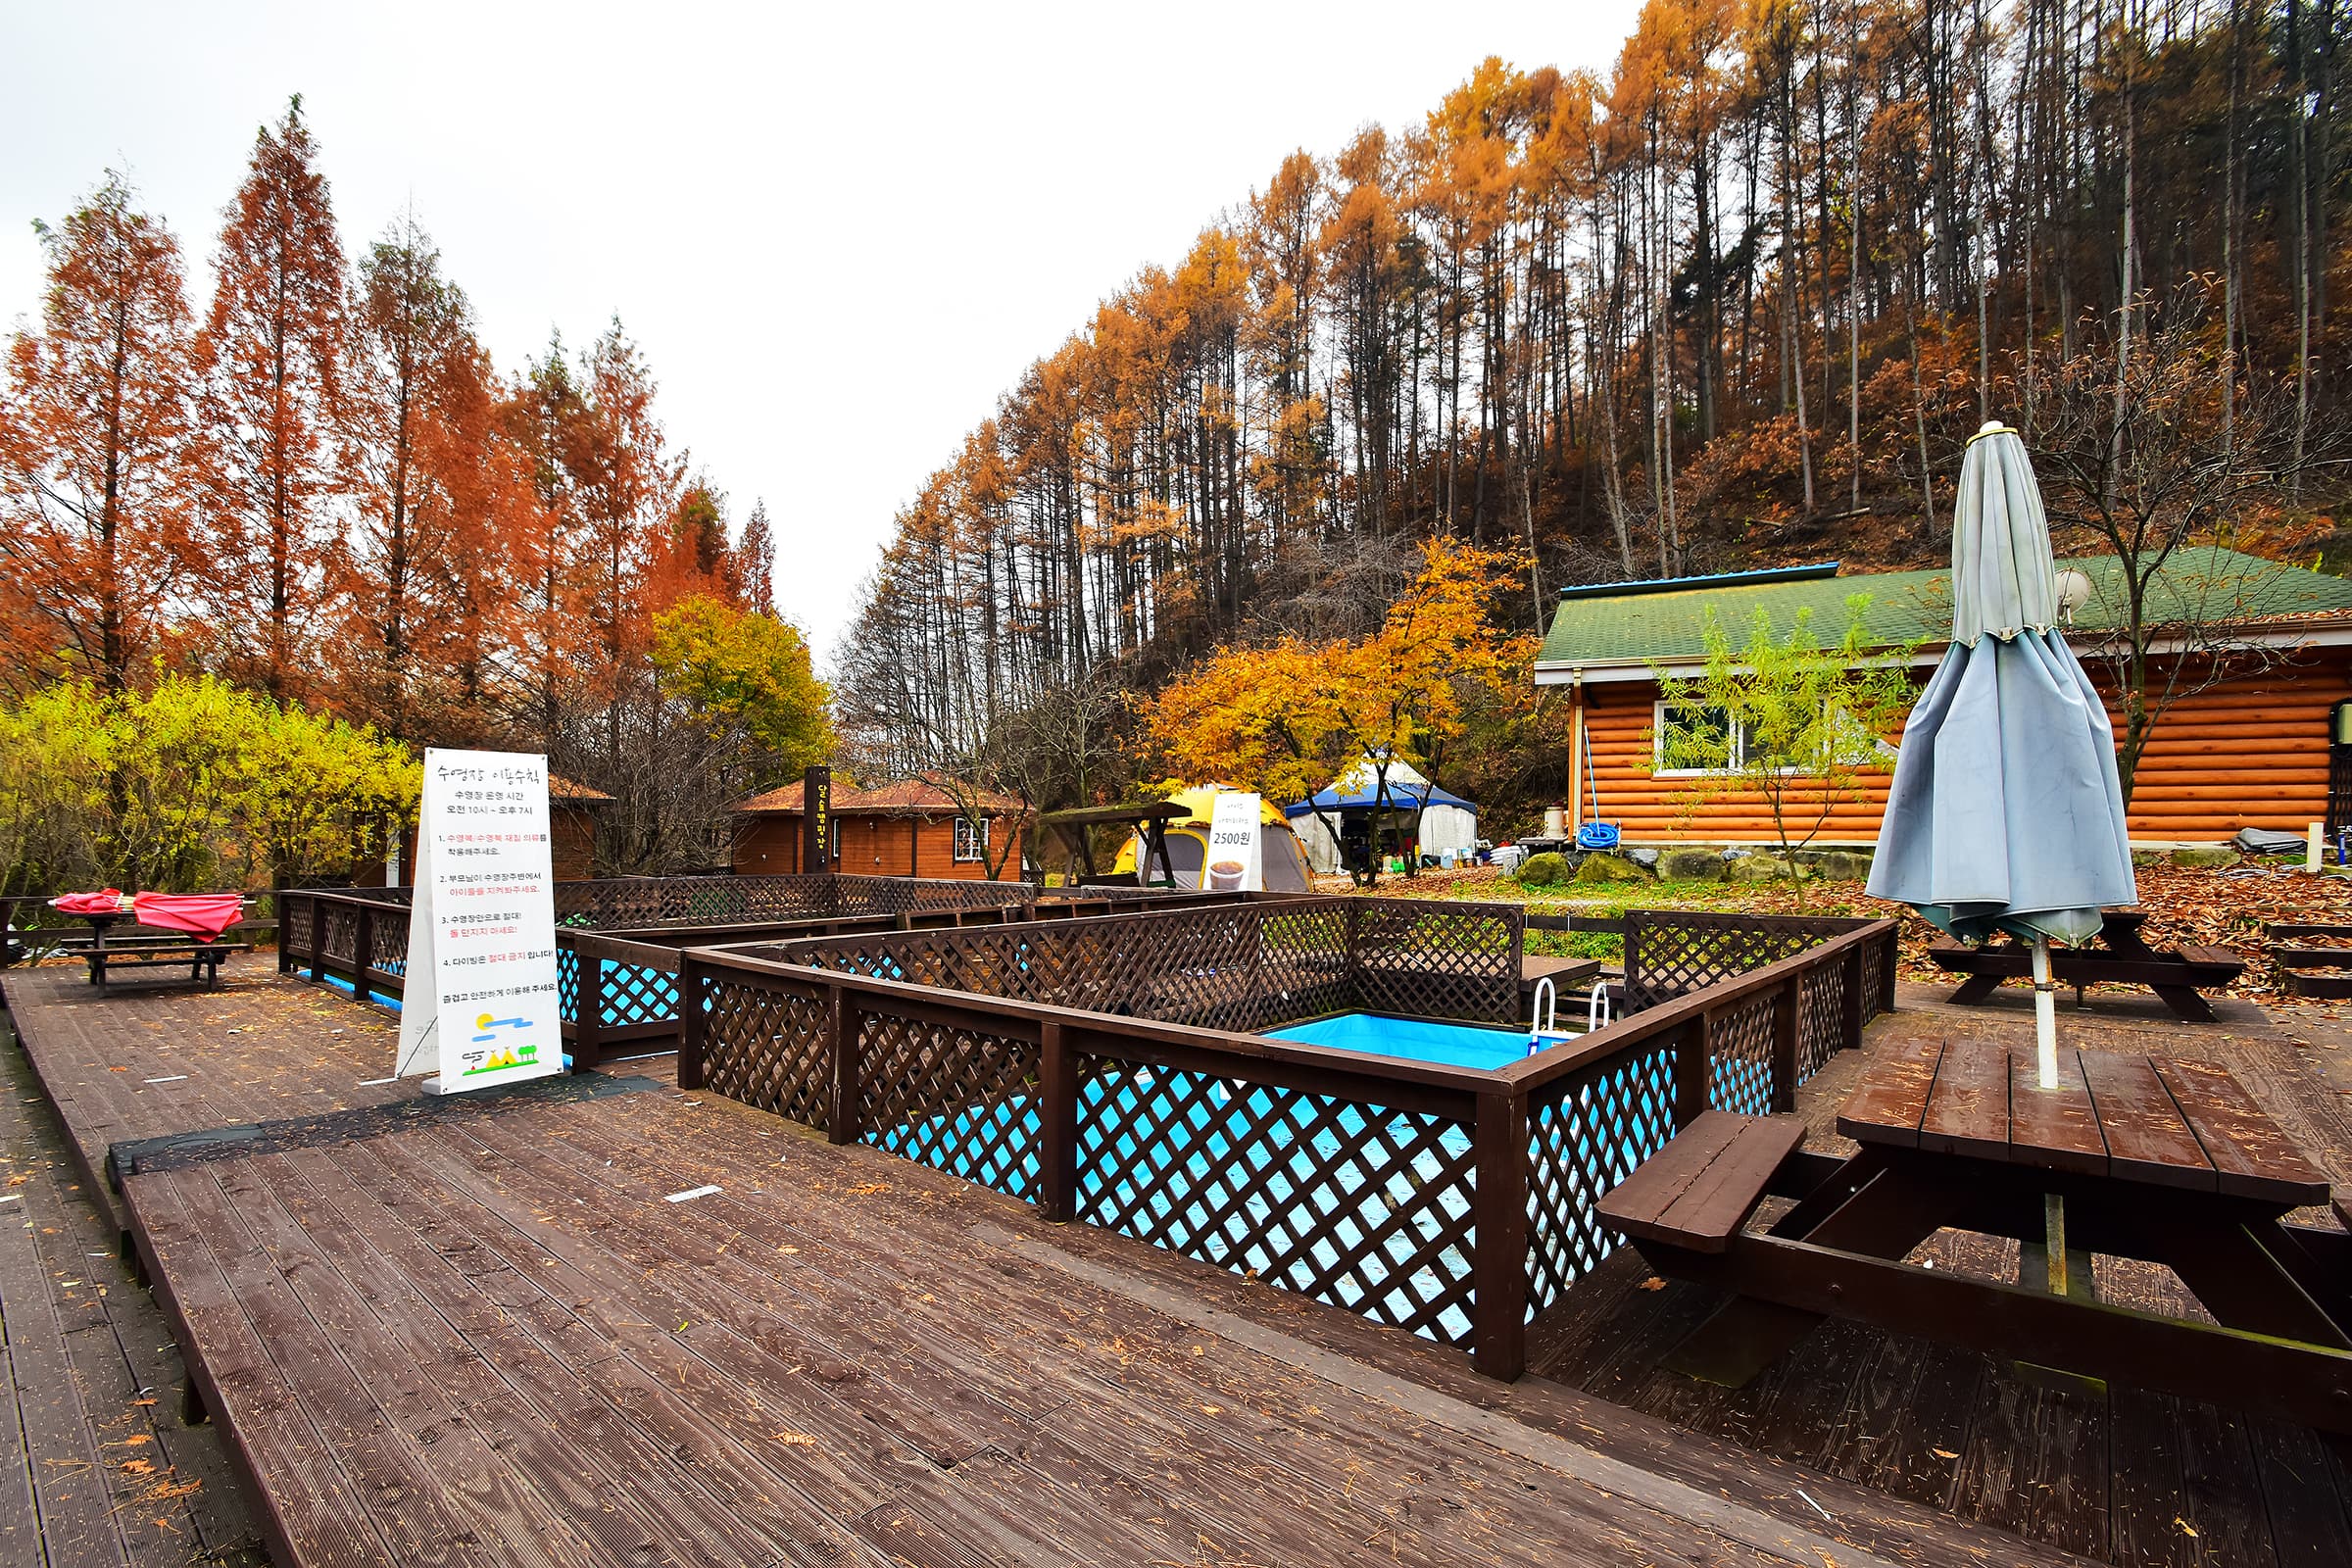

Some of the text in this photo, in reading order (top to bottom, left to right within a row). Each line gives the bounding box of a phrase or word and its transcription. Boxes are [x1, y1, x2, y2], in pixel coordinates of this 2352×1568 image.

[438, 765, 540, 786] 수영장 이용수칙
[454, 790, 484, 801] 수영장
[506, 792, 524, 801] 시간
[446, 805, 466, 814] 오전
[467, 806, 489, 815] 10시
[498, 806, 517, 815] 오후
[518, 807, 533, 815] 7시
[1213, 832, 1250, 846] 2500원
[449, 874, 483, 884] 부모님이
[453, 955, 486, 966] 다이빙은
[469, 989, 505, 1001] 안전하게
